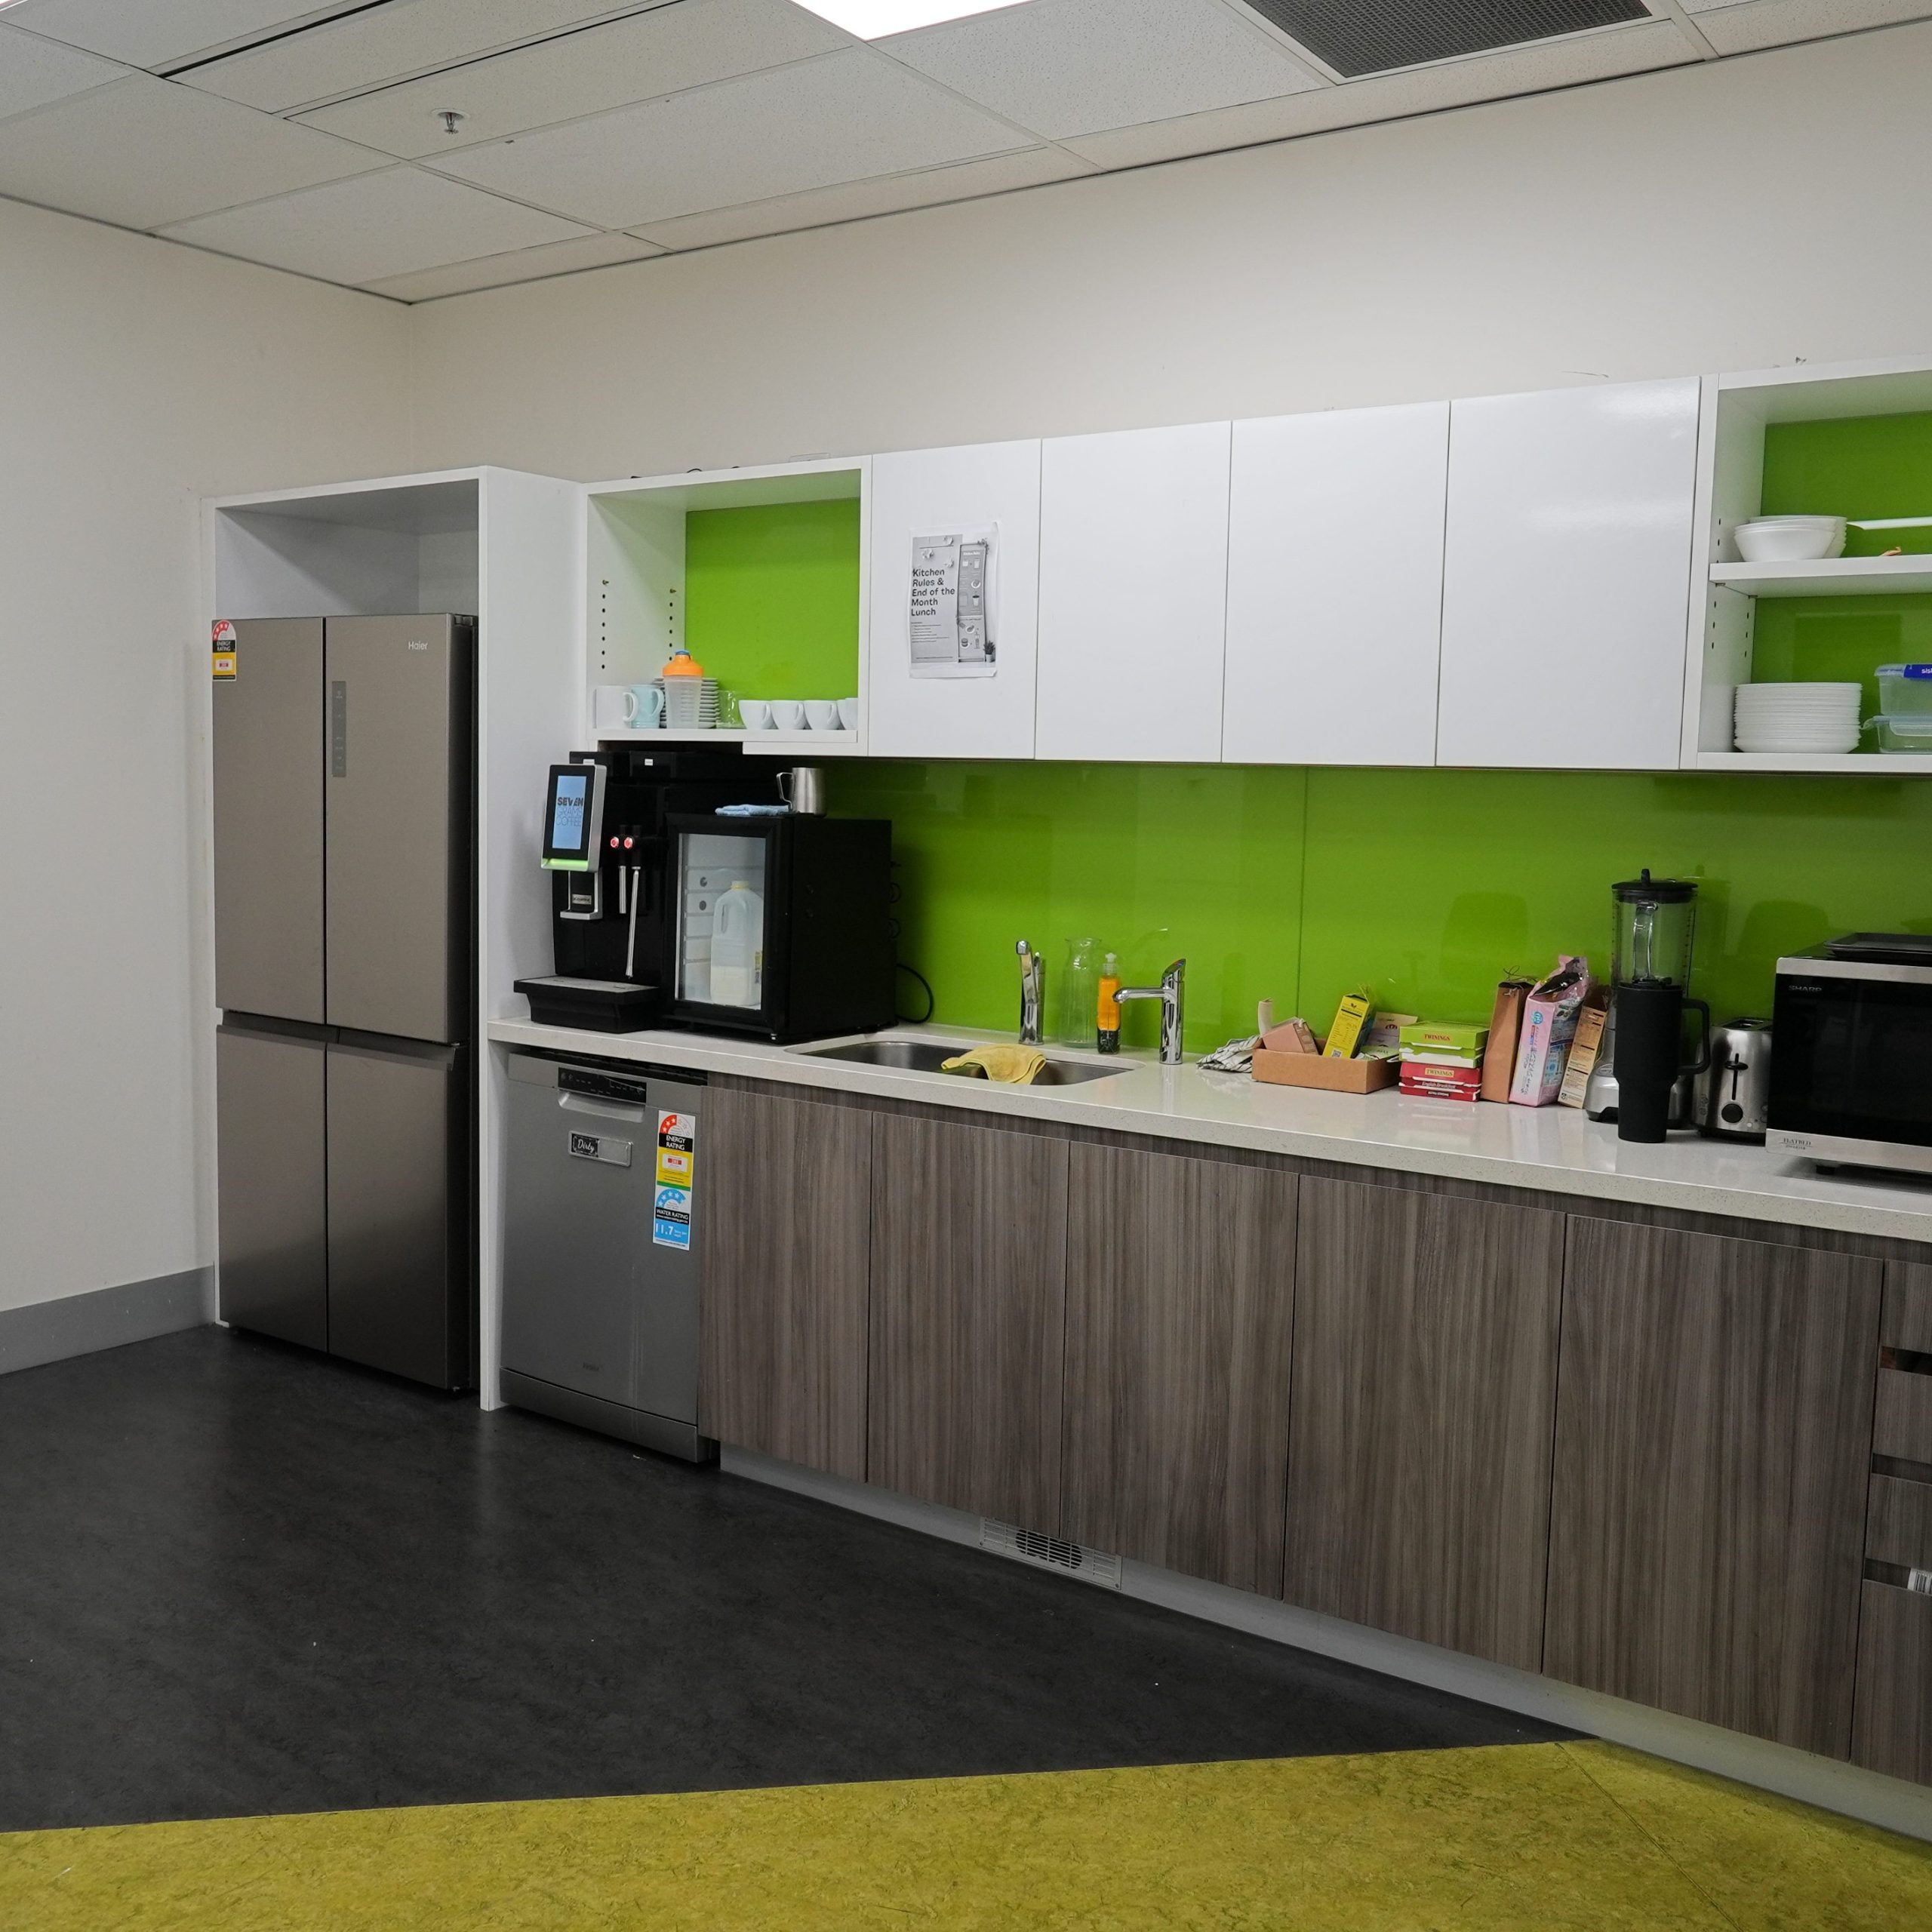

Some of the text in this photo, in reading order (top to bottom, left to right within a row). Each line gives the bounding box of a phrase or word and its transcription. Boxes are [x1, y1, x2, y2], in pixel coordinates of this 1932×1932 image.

[912, 568, 945, 577] Kitchen
[912, 577, 944, 587] Rules &
[912, 587, 955, 597] End of the
[912, 598, 938, 606] Month
[911, 608, 936, 617] Lunch
[408, 641, 428, 650] Haier
[555, 816, 582, 827] COFFEE
[666, 1135, 686, 1143] ENERGY
[578, 1139, 595, 1153] Dirty
[666, 1142, 685, 1150] RATING
[657, 1208, 672, 1217] WATER
[672, 1211, 689, 1220] RATING
[656, 1223, 674, 1235] 11.7
